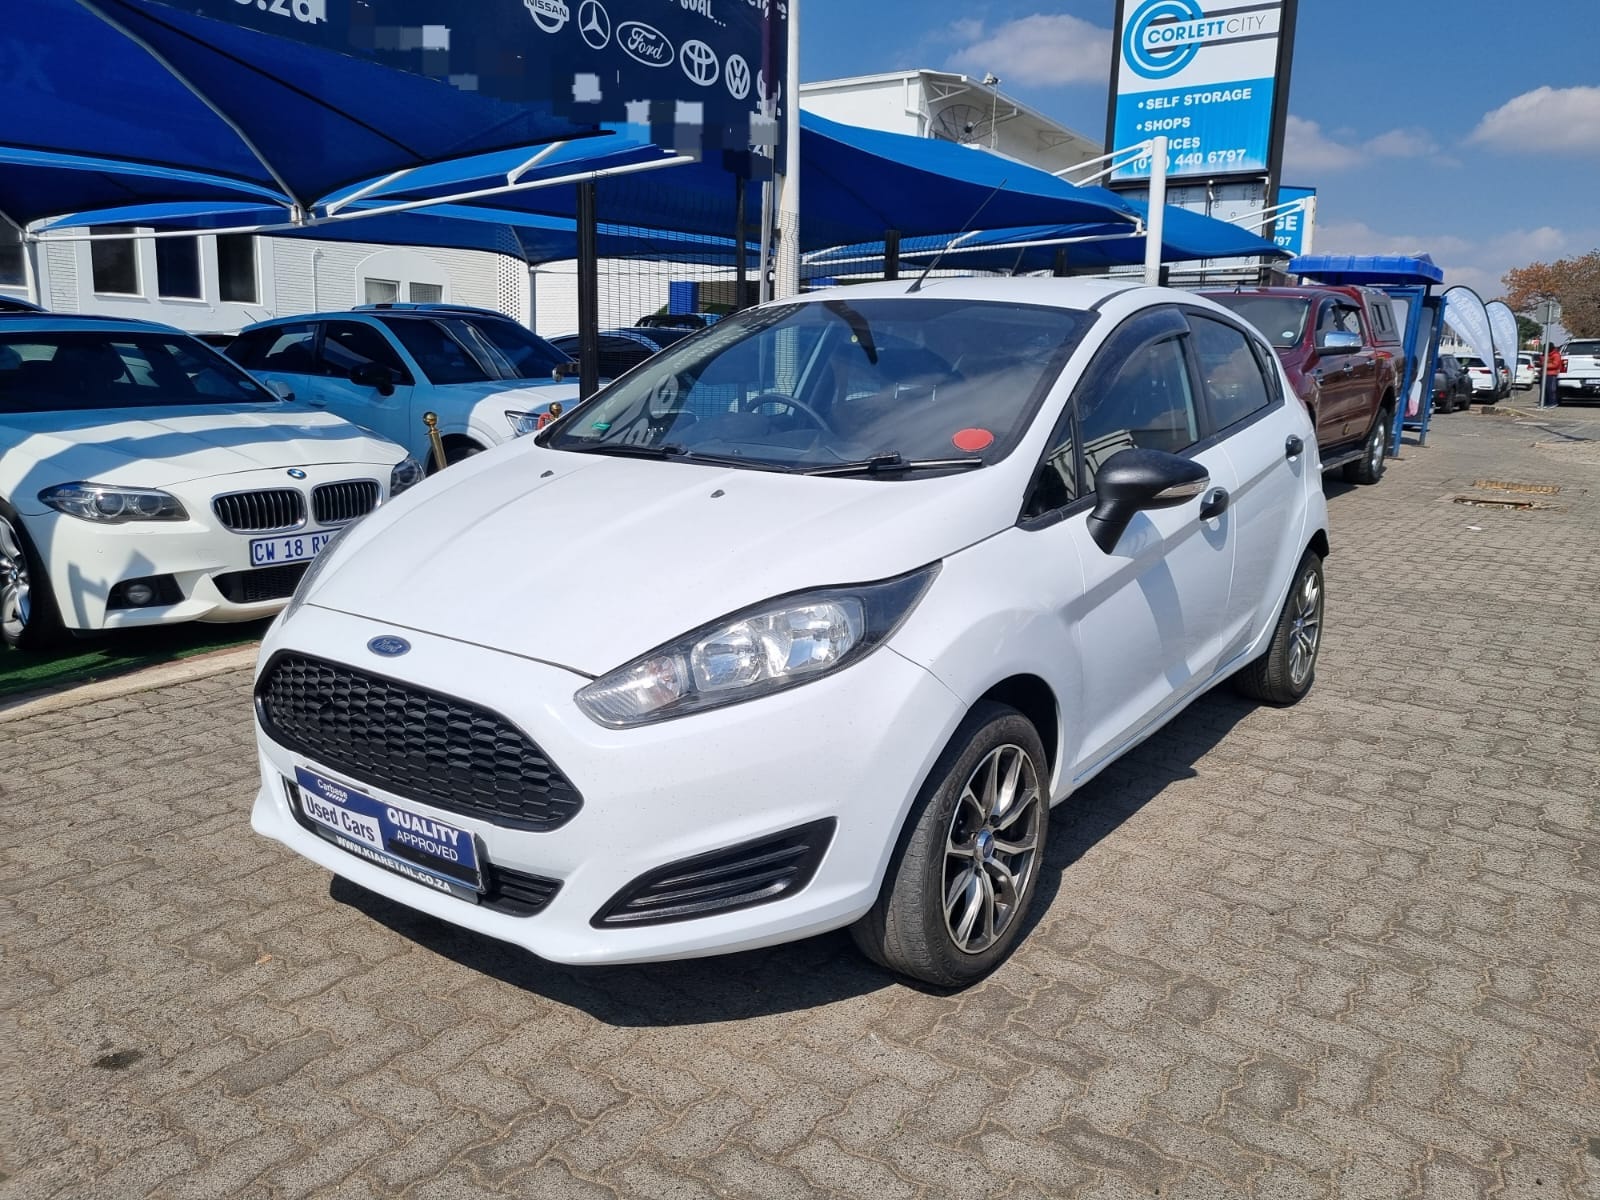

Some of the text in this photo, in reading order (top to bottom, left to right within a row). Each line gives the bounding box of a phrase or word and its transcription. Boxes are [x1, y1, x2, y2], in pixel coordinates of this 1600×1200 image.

[627, 27, 663, 60] Ford
[1145, 88, 1252, 111] SELF STORAGE
[1144, 117, 1191, 132] SHOPS
[1174, 152, 1204, 166] 440
[1207, 149, 1247, 164] 6797
[254, 542, 275, 562] CW
[284, 539, 304, 558] 18
[317, 778, 348, 799] Carbase
[305, 794, 376, 842] Used Cars
[386, 807, 460, 846] QUALITY
[396, 830, 459, 862] APPROVED
